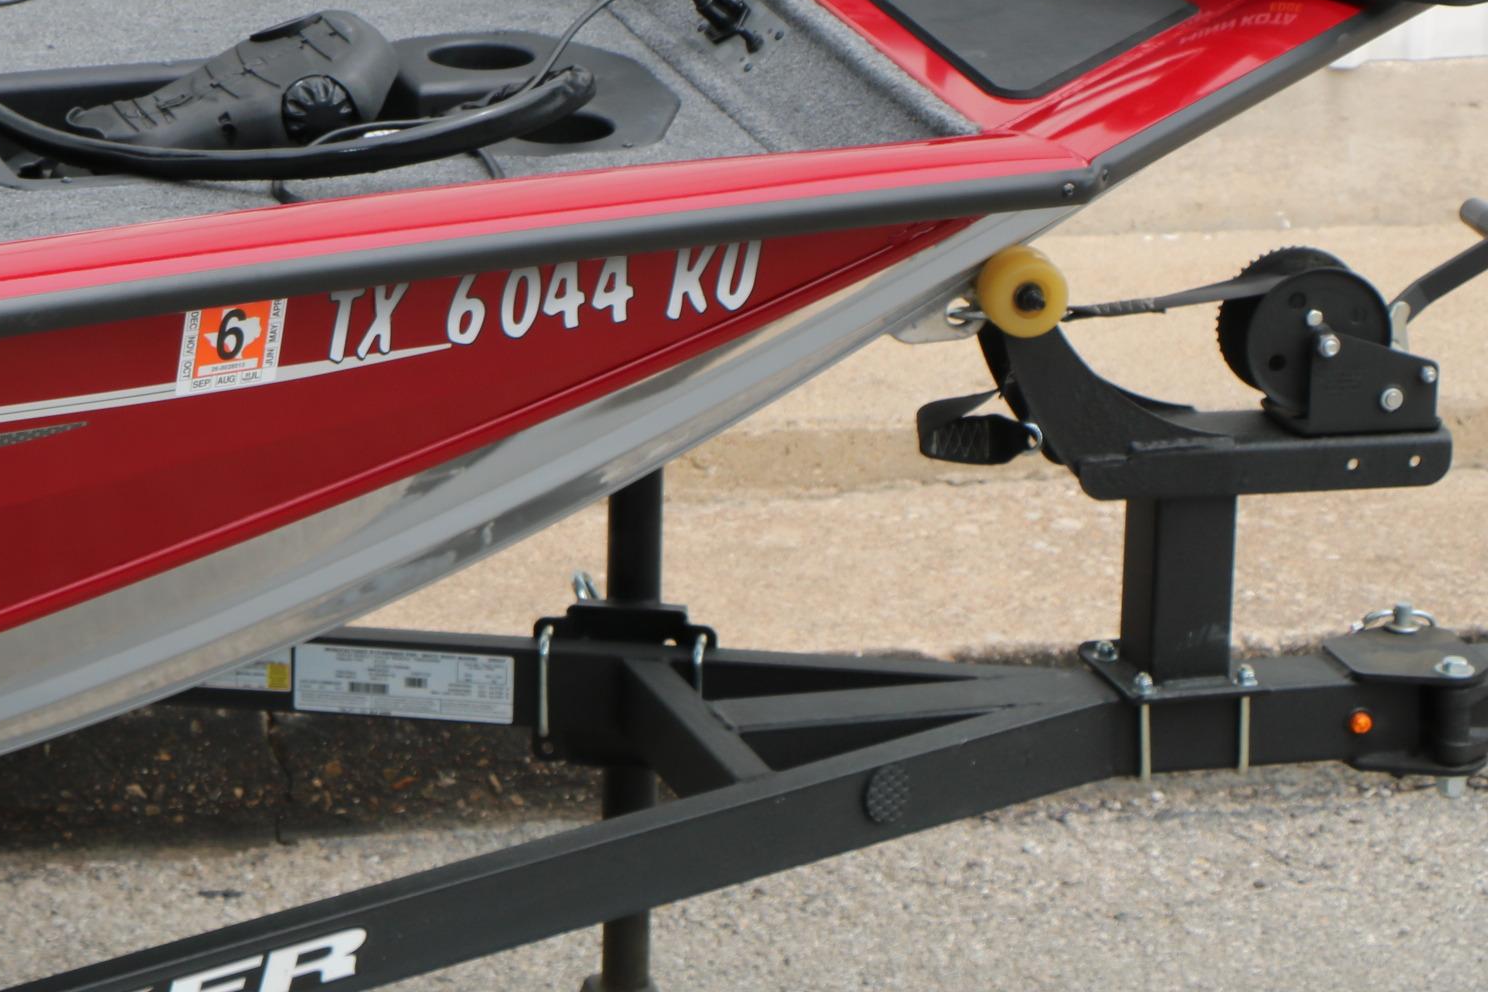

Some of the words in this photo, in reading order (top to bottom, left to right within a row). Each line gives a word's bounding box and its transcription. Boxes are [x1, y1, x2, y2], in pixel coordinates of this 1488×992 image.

[329, 284, 409, 363] TX
[446, 255, 634, 345] 6044
[666, 240, 761, 320] KU
[189, 311, 199, 330] DEC
[216, 308, 247, 361] 6
[269, 325, 279, 343] MAY
[185, 336, 195, 354] NOV
[183, 361, 192, 378] OCT
[193, 379, 211, 389] SEP
[217, 374, 236, 385] AUG
[149, 927, 368, 992] ER
